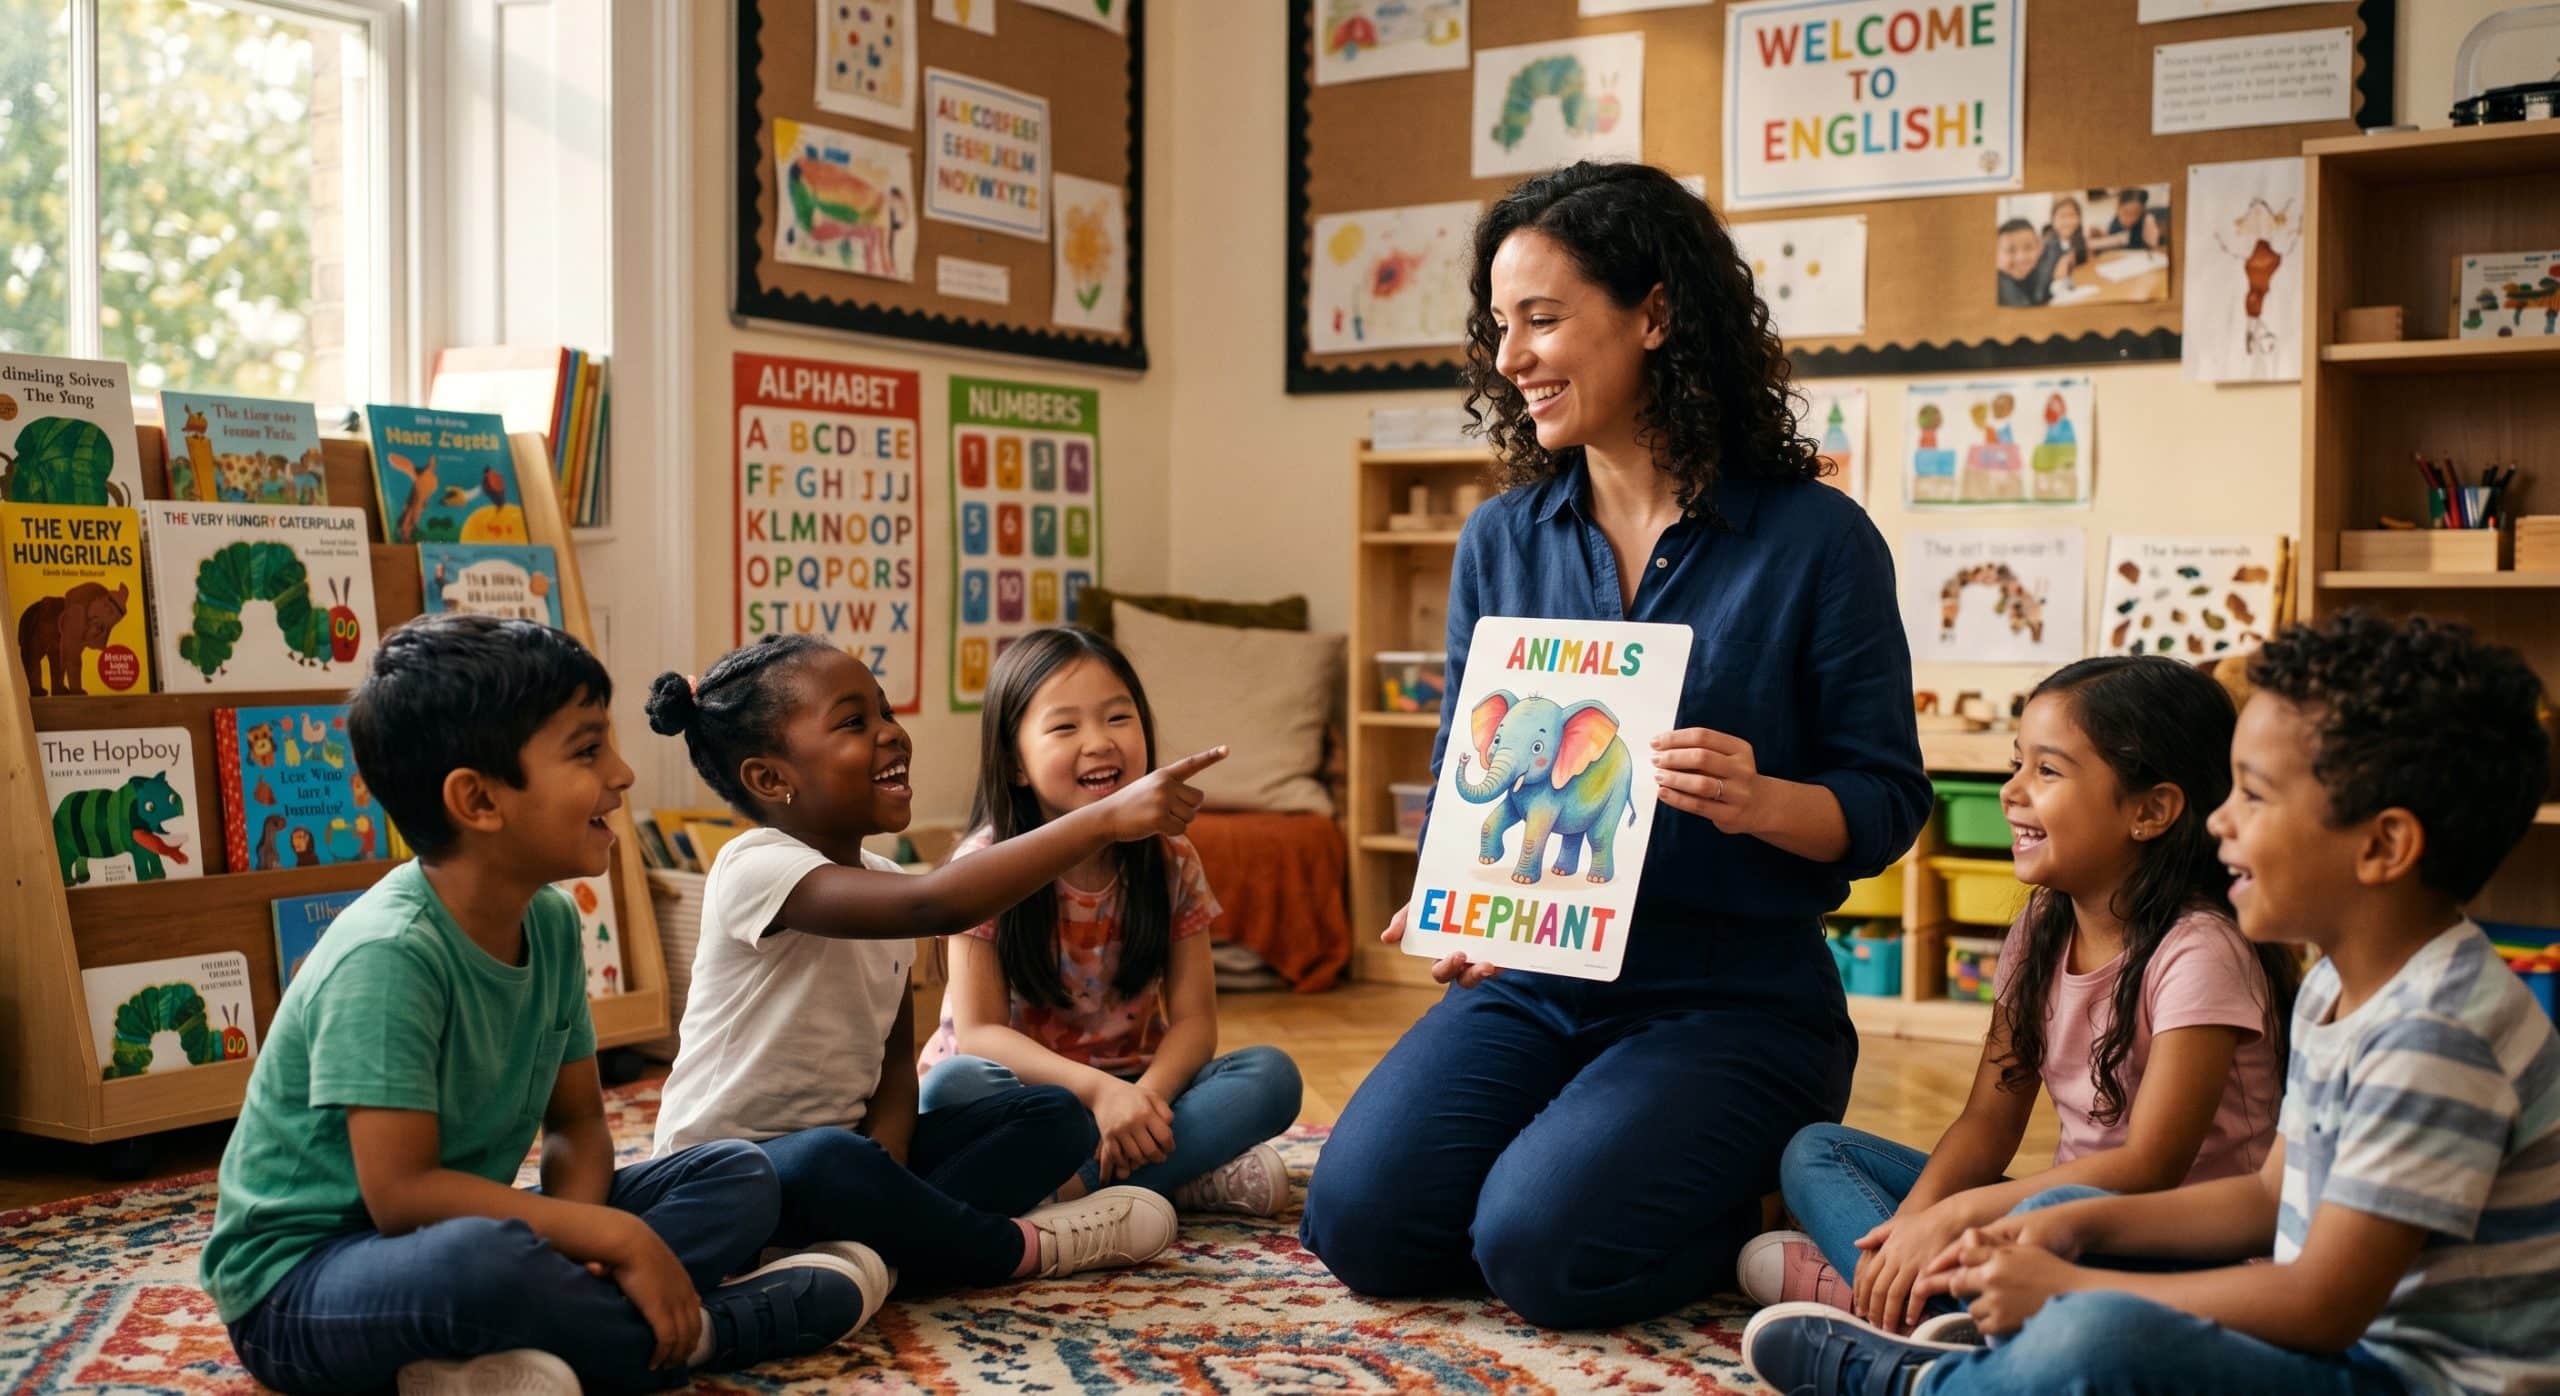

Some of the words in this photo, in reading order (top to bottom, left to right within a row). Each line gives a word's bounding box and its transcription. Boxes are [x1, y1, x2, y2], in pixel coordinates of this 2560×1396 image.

[1757, 2, 1996, 68] WELCOME
[1848, 67, 1896, 101] TO
[1764, 101, 1984, 162] ENGLISH!
[24, 387, 54, 402] The
[758, 365, 899, 410] ALPHABET
[968, 386, 1083, 426] NUMBERS
[747, 416, 767, 449] A
[968, 442, 979, 468] 1
[1003, 444, 1016, 470] 2
[1037, 445, 1050, 472] 3
[1070, 448, 1083, 472] 4
[21, 517, 63, 540] THE
[68, 519, 122, 541] VERY
[164, 511, 188, 526] THE
[192, 513, 224, 527] VERY
[226, 514, 277, 528] HUNGRY
[279, 515, 355, 530] CATERPILLAR
[969, 508, 981, 535] 5
[1003, 509, 1016, 535] 6
[1038, 511, 1052, 536] 7
[13, 543, 133, 567] HUNGRILAS
[968, 576, 982, 602] 9
[1000, 577, 1021, 602] 10
[1506, 637, 1644, 676] ANIMALS
[42, 740, 85, 764] The
[93, 737, 180, 767] Hopboy
[1419, 888, 1616, 952] ELEPHANT
